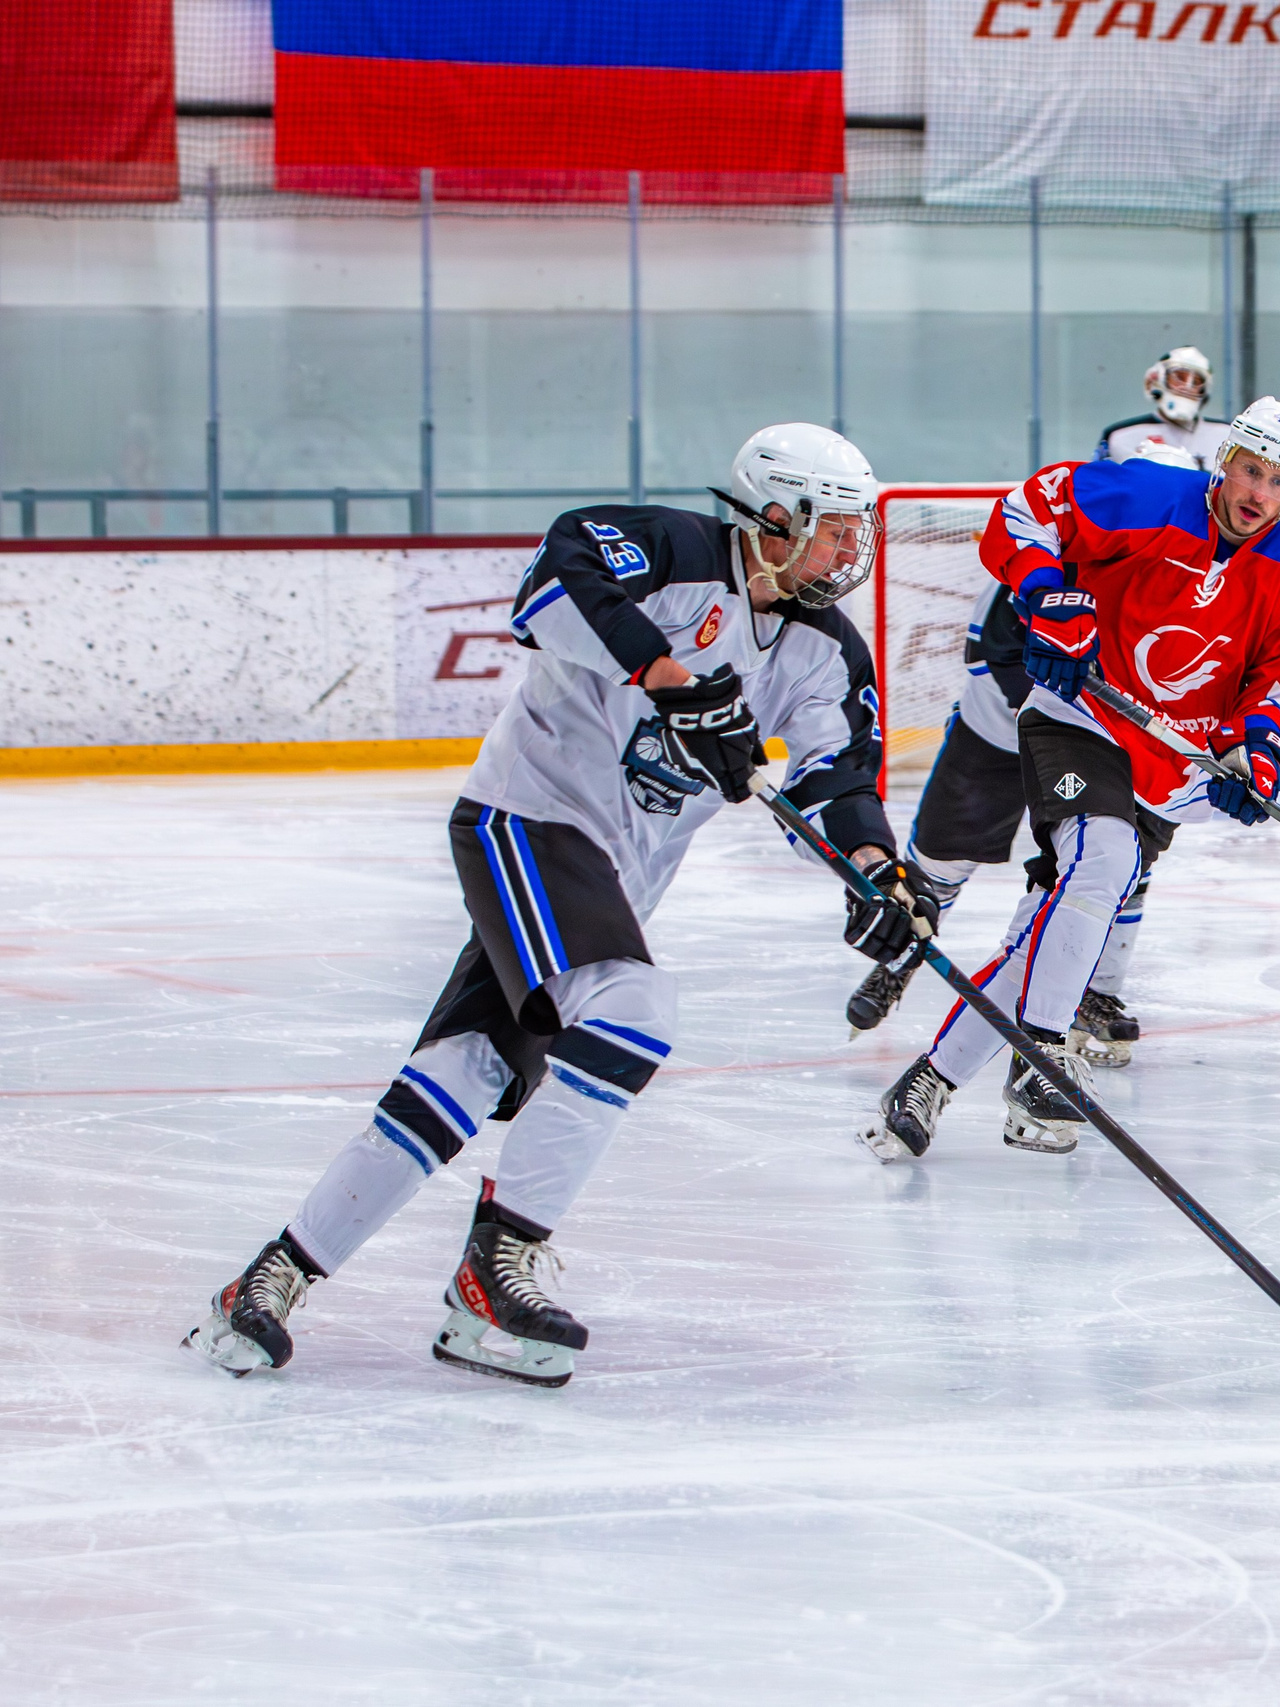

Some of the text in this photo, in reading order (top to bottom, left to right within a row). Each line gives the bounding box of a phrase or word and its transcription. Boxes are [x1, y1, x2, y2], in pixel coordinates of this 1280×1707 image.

[768, 474, 804, 488] BAUER
[581, 520, 650, 581] 13
[460, 1266, 492, 1320] CCM
